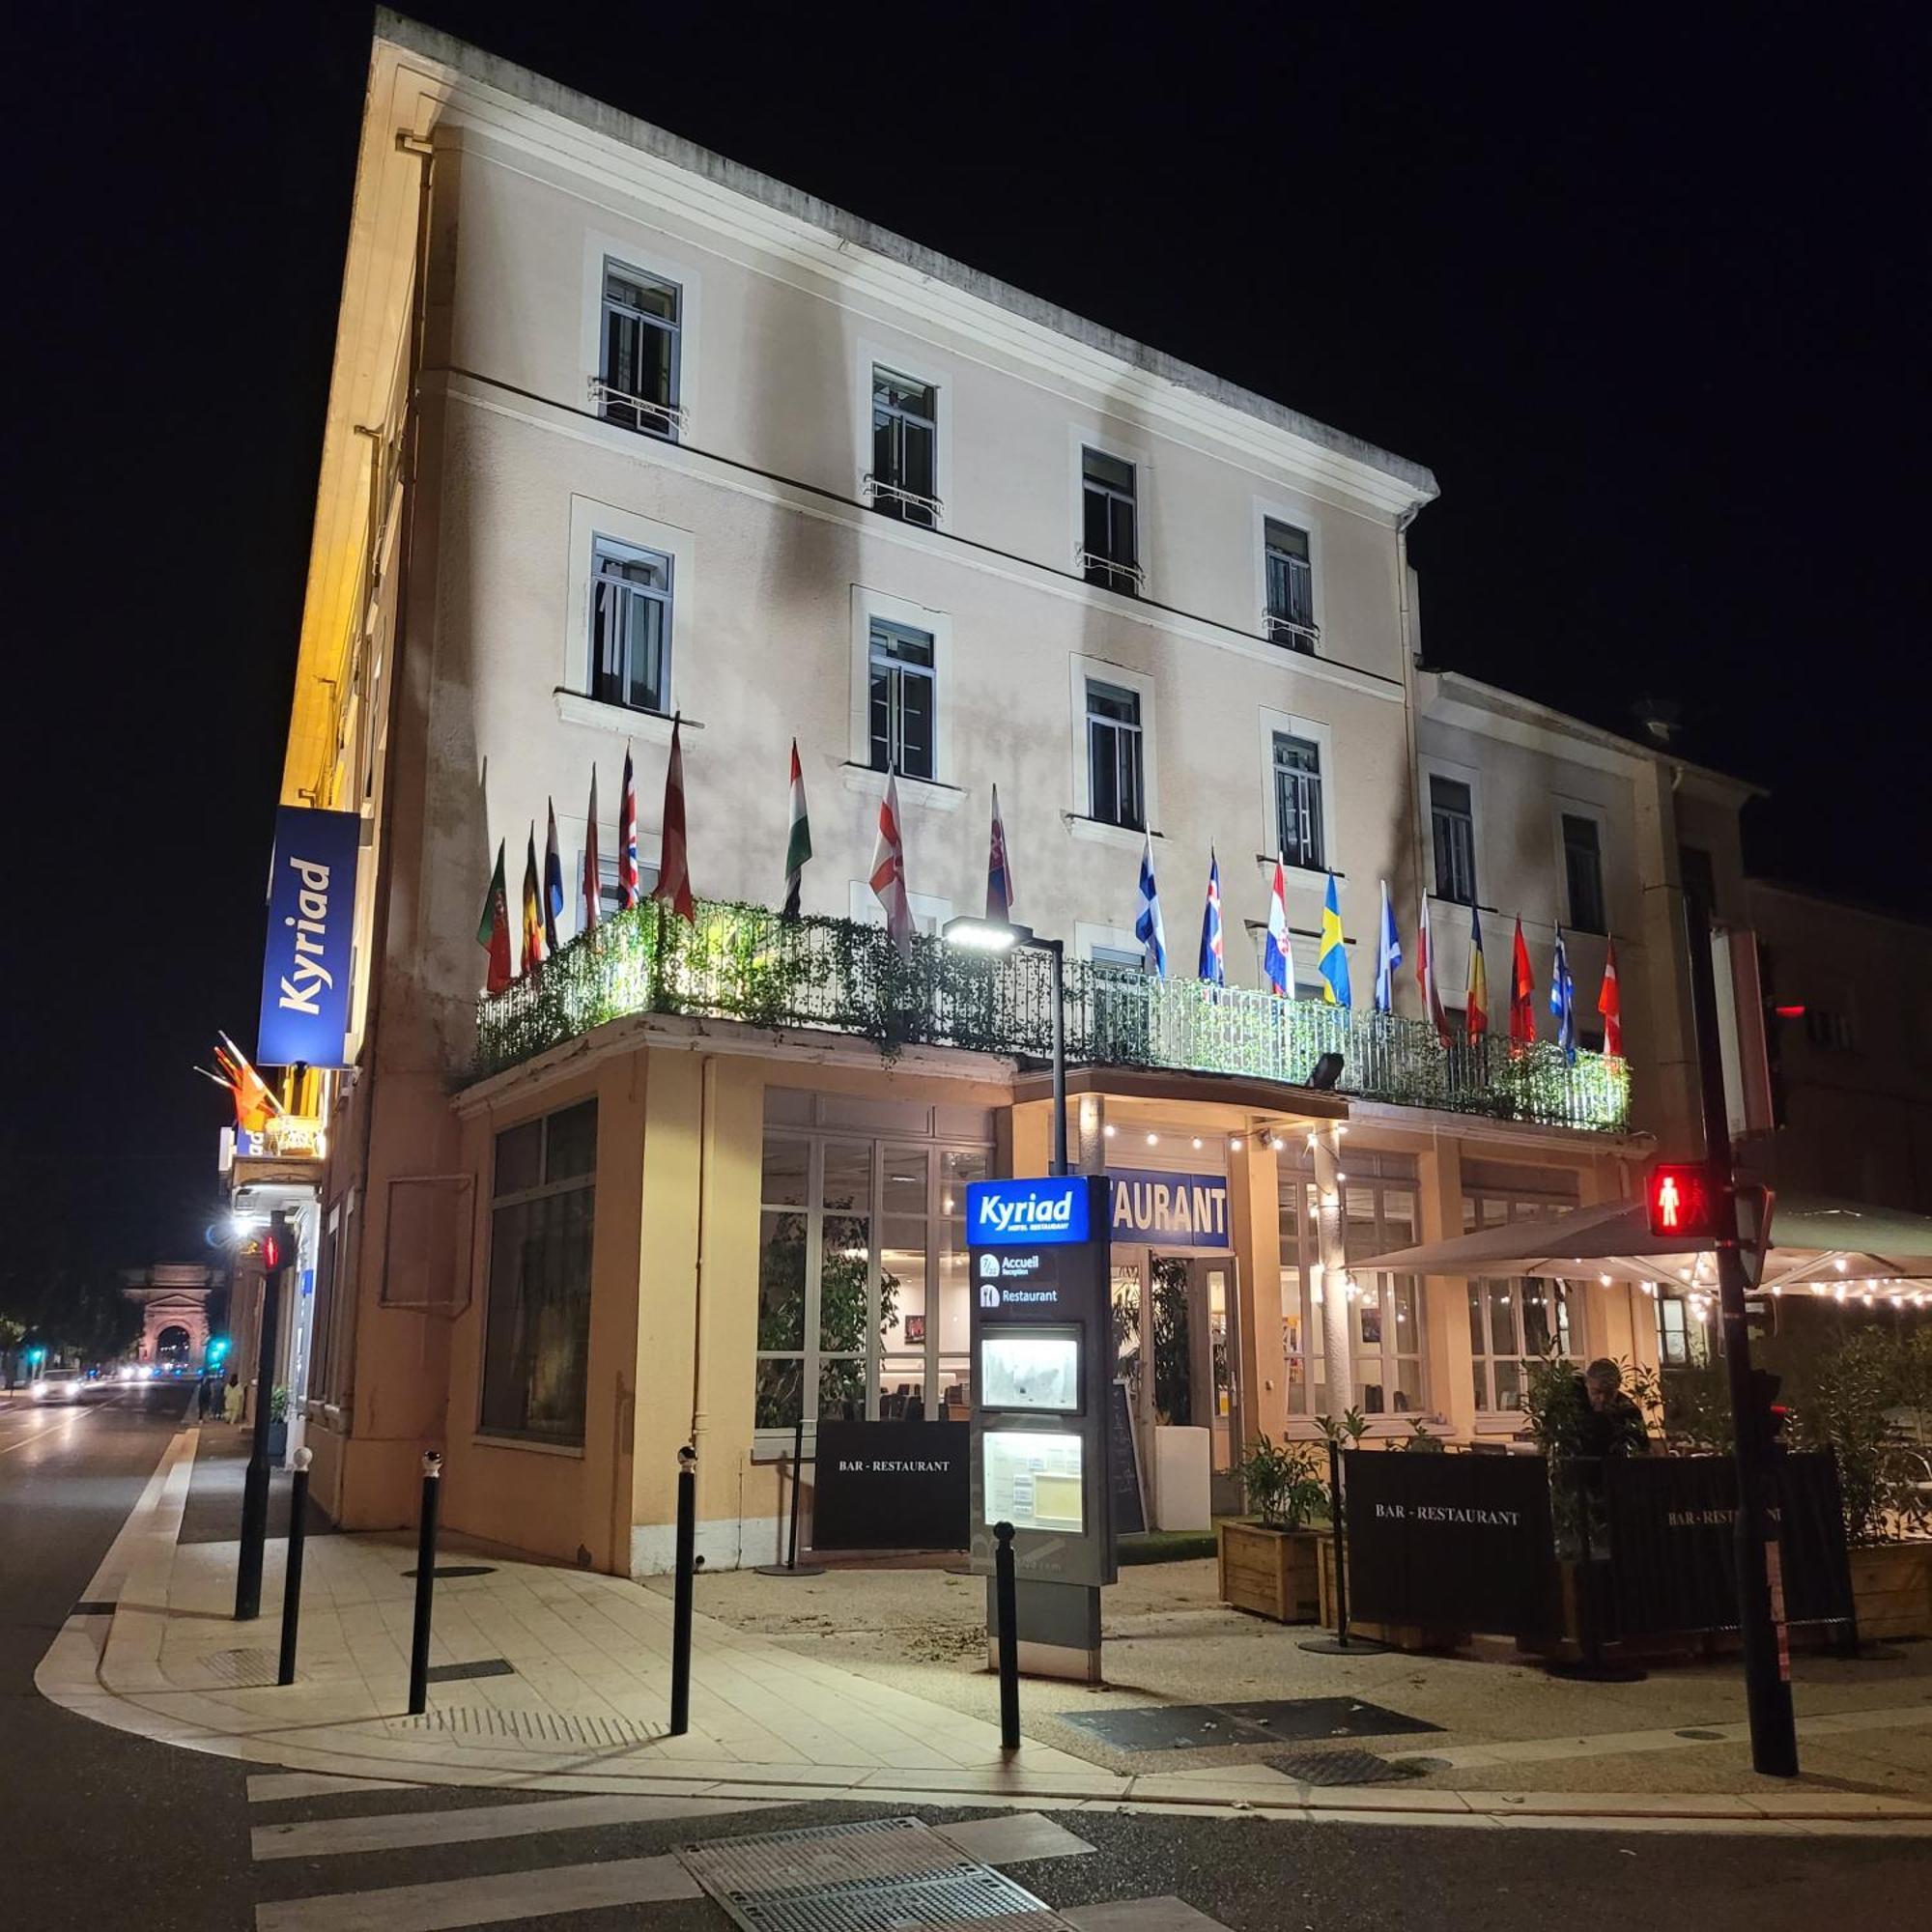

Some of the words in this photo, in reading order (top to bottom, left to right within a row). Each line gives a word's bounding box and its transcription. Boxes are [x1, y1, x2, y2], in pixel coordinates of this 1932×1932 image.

[278, 856, 333, 1015] Kyriad
[244, 1129, 264, 1156] ad
[979, 1191, 1073, 1232] Kyriad
[1002, 1255, 1039, 1269] Accueil
[1002, 1289, 1058, 1303] Restaurant
[838, 1461, 864, 1472] BAR
[872, 1461, 951, 1472] RESTAURANT
[1376, 1503, 1406, 1519] BAR
[1417, 1506, 1520, 1526] RESTAURANT
